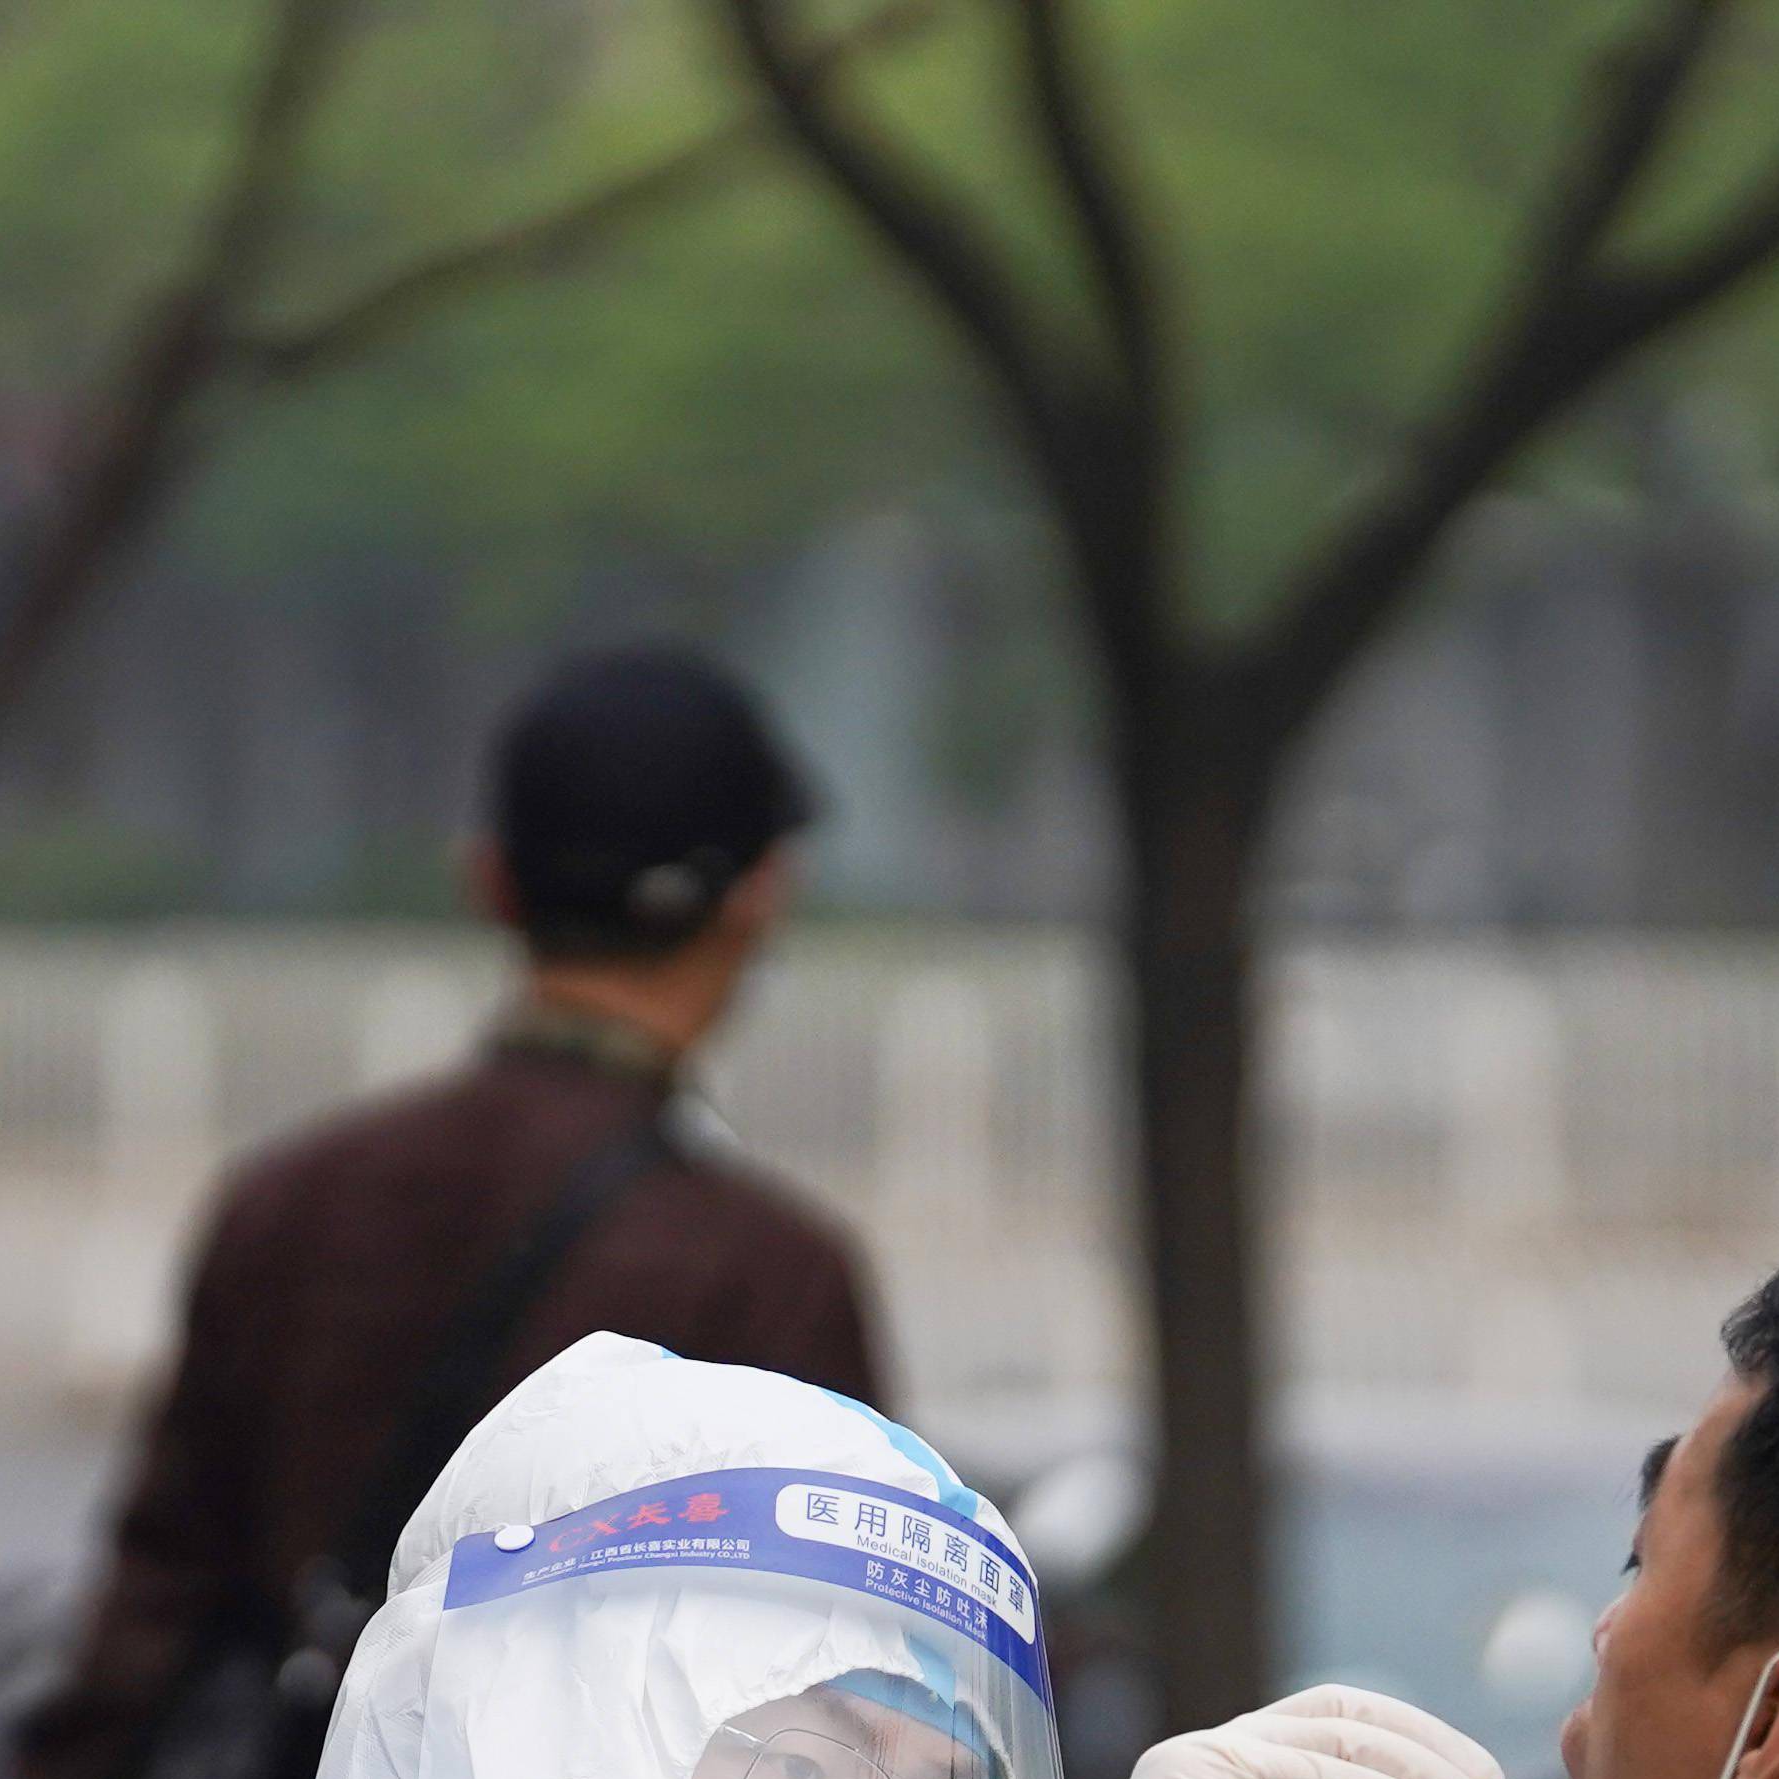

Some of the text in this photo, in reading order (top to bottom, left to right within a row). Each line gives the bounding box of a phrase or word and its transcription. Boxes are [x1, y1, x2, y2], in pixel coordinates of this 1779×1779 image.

[806, 1492, 1025, 1615] 医用隔离面罩
[856, 1535, 913, 1562] Medical
[864, 1578, 920, 1606] Protective
[866, 1559, 989, 1630] 防灰尘防吐沫
